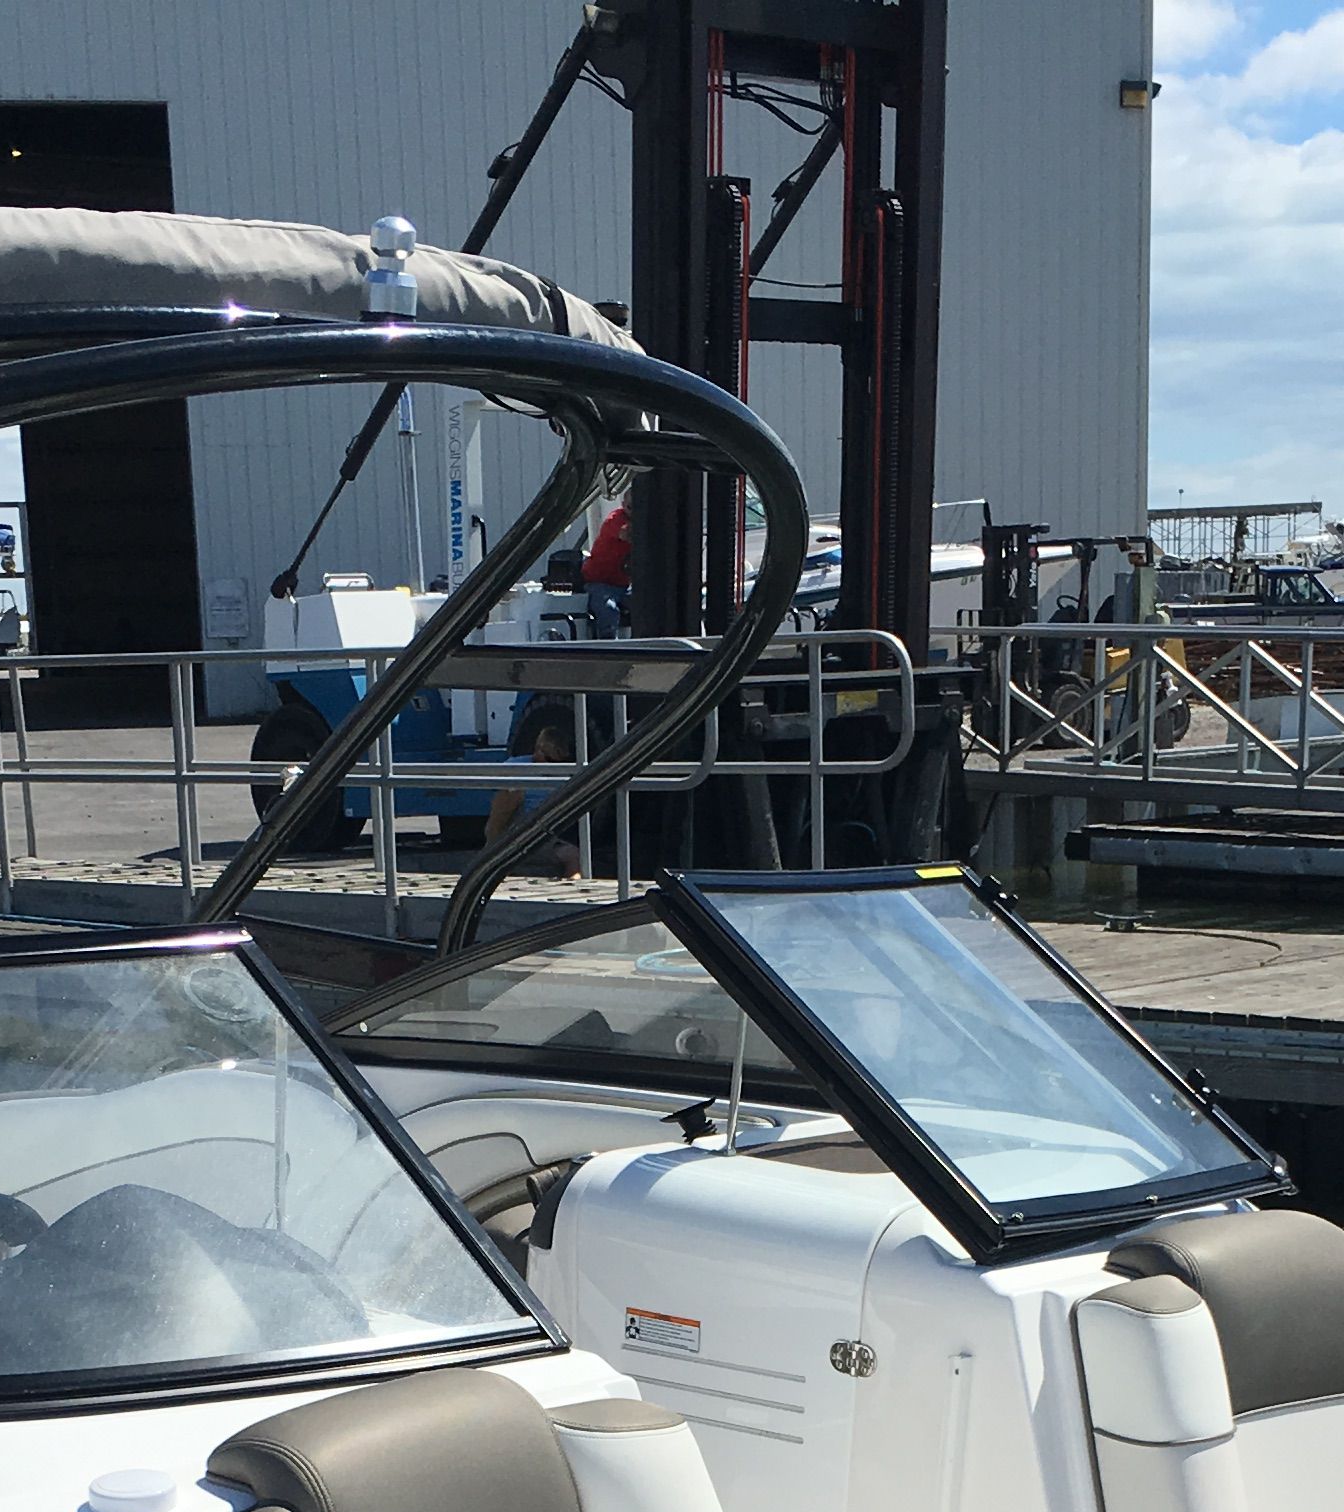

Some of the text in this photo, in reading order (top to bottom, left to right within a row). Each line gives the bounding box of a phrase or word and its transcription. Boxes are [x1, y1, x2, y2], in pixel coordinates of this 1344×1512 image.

[448, 405, 461, 480] WIGGINS
[450, 480, 463, 561] MARINA
[1029, 561, 1037, 588] Yale
